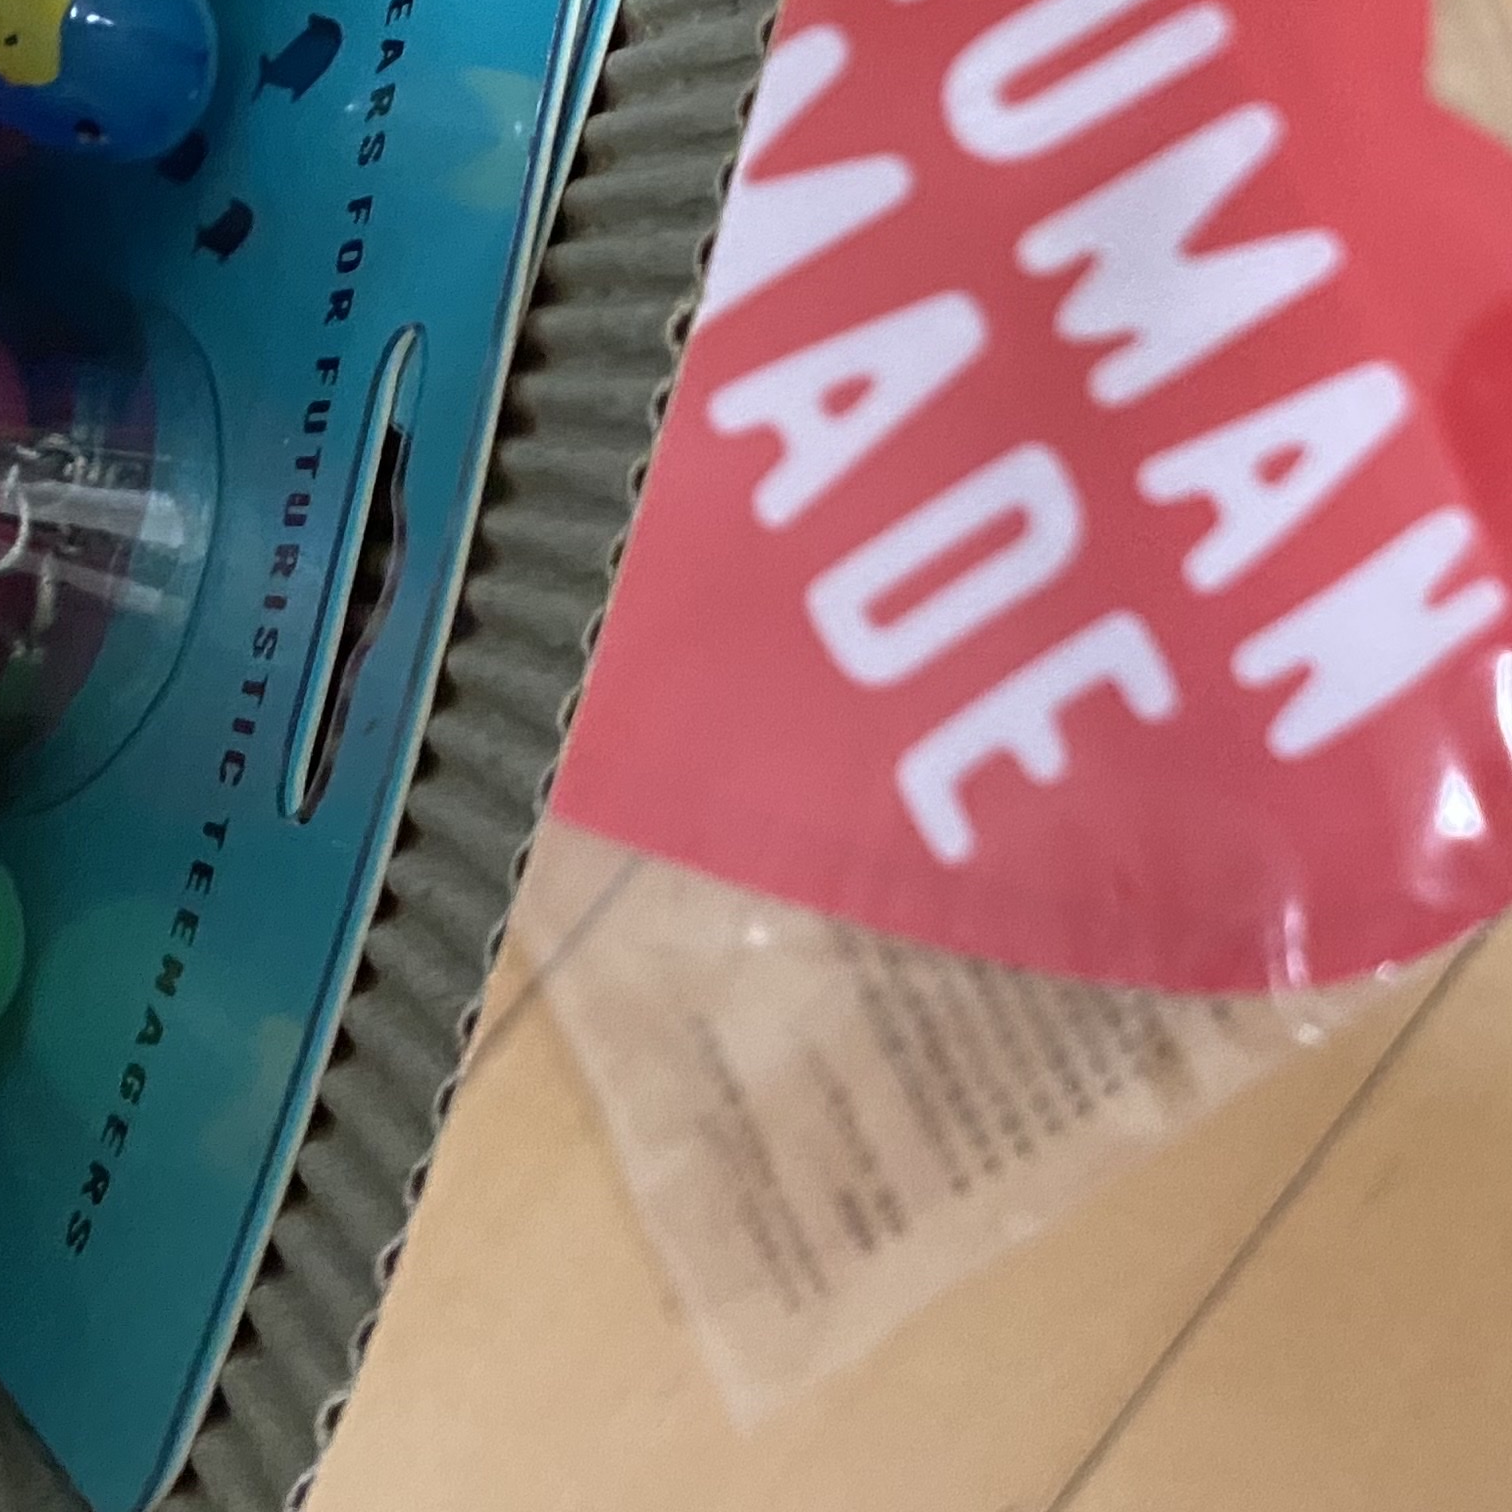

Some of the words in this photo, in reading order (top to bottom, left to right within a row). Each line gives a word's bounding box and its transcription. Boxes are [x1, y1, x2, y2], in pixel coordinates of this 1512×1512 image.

[324, 194, 374, 325] FOR
[218, 356, 341, 787] FUTURISTIC
[64, 815, 231, 1257] TEENAGERS
